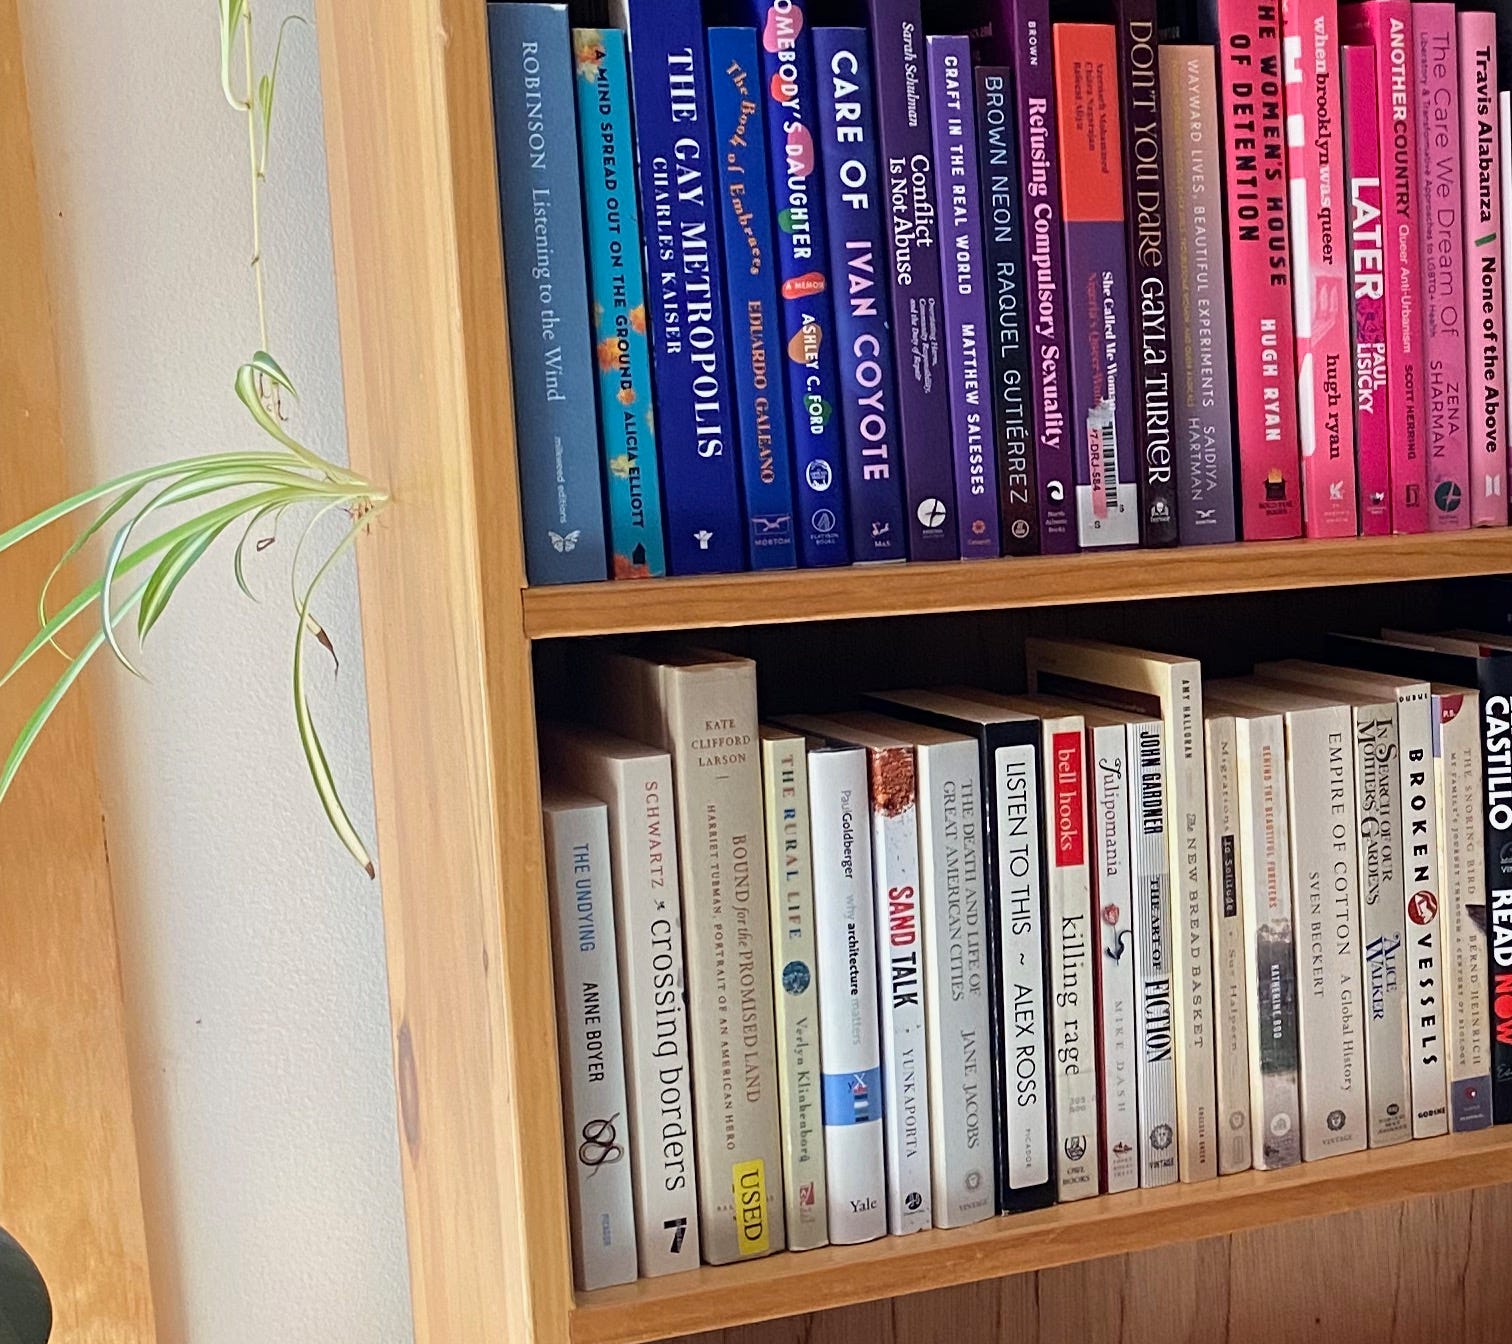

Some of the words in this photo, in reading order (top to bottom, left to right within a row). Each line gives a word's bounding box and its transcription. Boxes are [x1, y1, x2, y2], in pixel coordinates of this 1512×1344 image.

[667, 48, 695, 122] THE
[831, 50, 864, 143] CARE
[673, 137, 702, 206] GAY
[890, 158, 907, 173] Is
[1027, 97, 1052, 197] Refusing
[785, 143, 811, 259] DAUGHTER
[839, 160, 868, 211] OF
[891, 178, 911, 213] Not
[910, 154, 932, 247] Conflict
[530, 187, 554, 279] Listening
[893, 217, 915, 285] Abuse
[1351, 177, 1383, 300] LATER
[537, 284, 554, 304] to
[845, 240, 877, 317] IVAN
[1031, 203, 1058, 339] Compulsory
[1481, 256, 1497, 314] None
[539, 309, 557, 341] the
[679, 220, 724, 459] METROPOLIS
[995, 262, 1020, 358] RAQUEL
[1483, 318, 1498, 340] of
[542, 347, 565, 402] Wind
[1259, 319, 1278, 378] HUGH
[1356, 342, 1375, 415] LISICKY
[1370, 342, 1387, 389] PAUL
[1484, 345, 1498, 381] the
[854, 334, 889, 481] COYOTE
[1038, 344, 1063, 448] Sexuality
[1263, 387, 1282, 442] RYAN
[1484, 386, 1500, 453] Above
[553, 436, 565, 486] milkweed
[1004, 369, 1030, 504] GUTIÉRREZ
[557, 489, 569, 524] editions
[1058, 748, 1074, 787] bell
[1140, 730, 1161, 768] JOHN
[1328, 732, 1346, 815] EMPIRE
[1059, 792, 1076, 851] hooks
[1142, 772, 1163, 835] GARDNER
[1408, 748, 1430, 883] BROKEN
[1333, 824, 1347, 853] OF
[887, 885, 916, 946] SAND
[1333, 861, 1351, 955] COTTON
[649, 919, 680, 1057] crossing
[846, 922, 861, 995] architecture
[892, 952, 919, 1008] TALK
[1058, 915, 1083, 1007] killing
[583, 982, 602, 1024] ANNE
[1014, 983, 1034, 1037] ALEX
[1144, 979, 1173, 1063] FICTION
[1417, 933, 1438, 1067] VESSELS
[586, 1030, 605, 1082] BOYER
[1017, 1045, 1036, 1107] ROSS
[1059, 1019, 1082, 1076] rage
[658, 1066, 689, 1190] borders
[740, 1170, 762, 1241] USED
